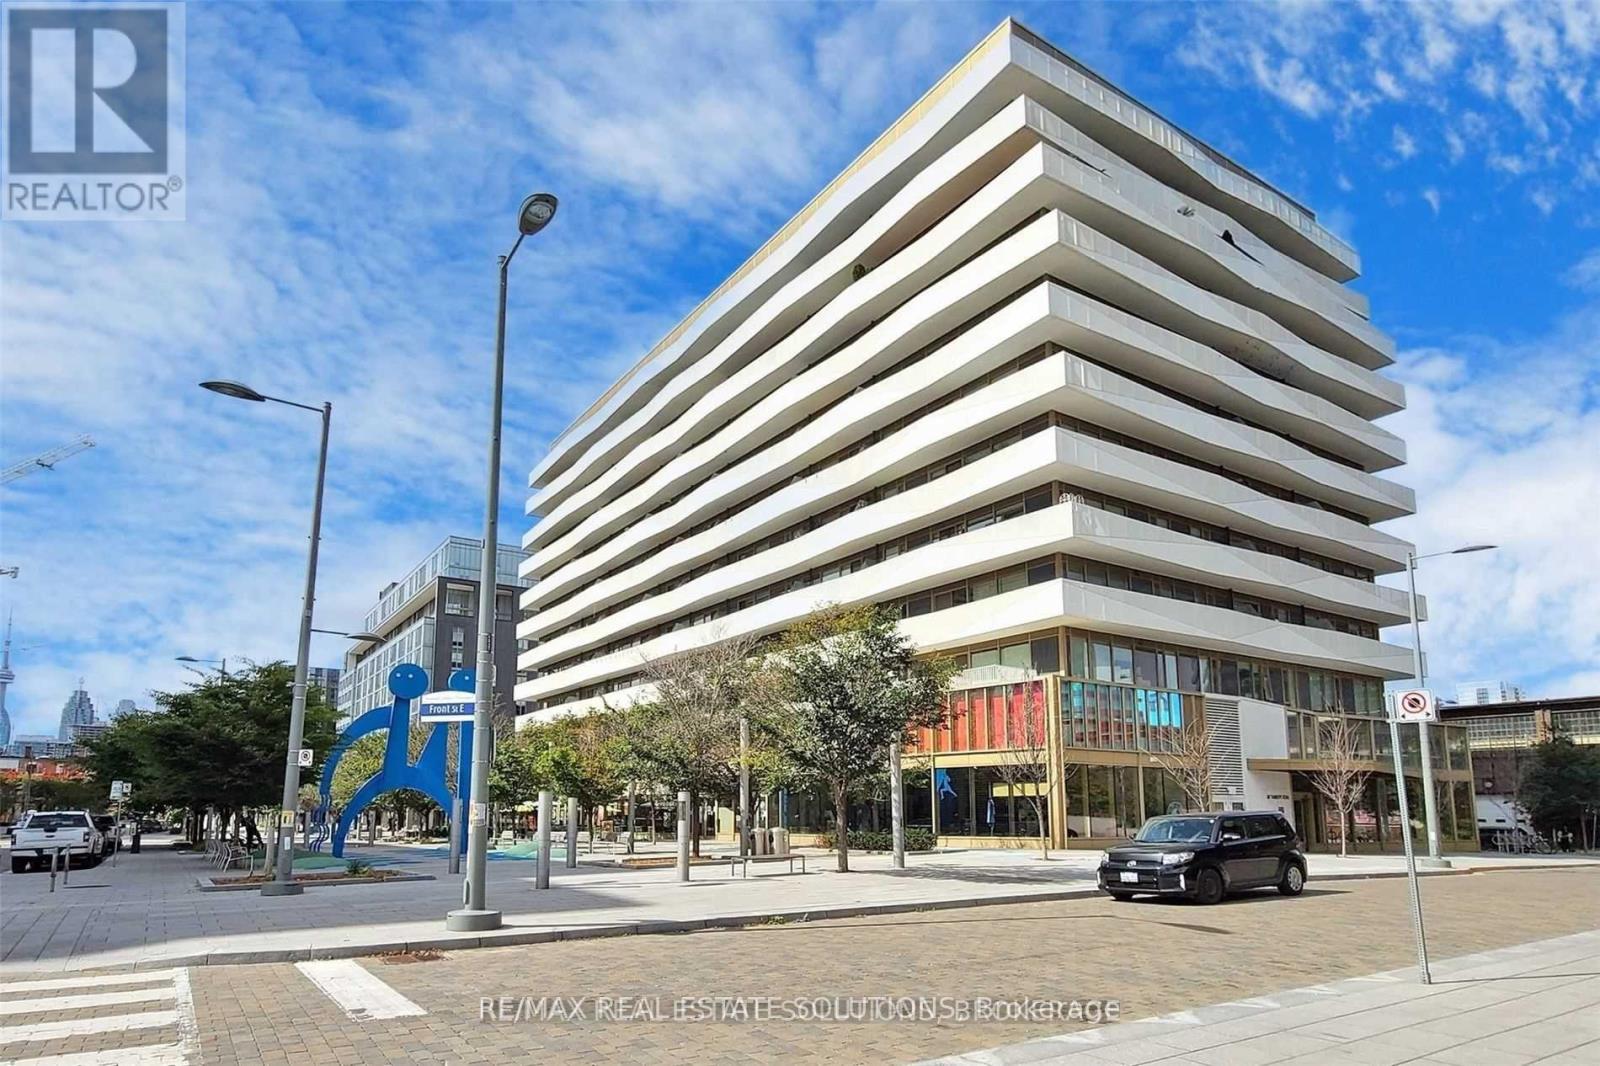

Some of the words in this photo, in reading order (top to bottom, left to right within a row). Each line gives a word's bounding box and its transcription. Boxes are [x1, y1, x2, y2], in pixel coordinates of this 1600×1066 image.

[429, 704, 450, 714] Front
[451, 705, 459, 713] St
[459, 703, 465, 713] E
